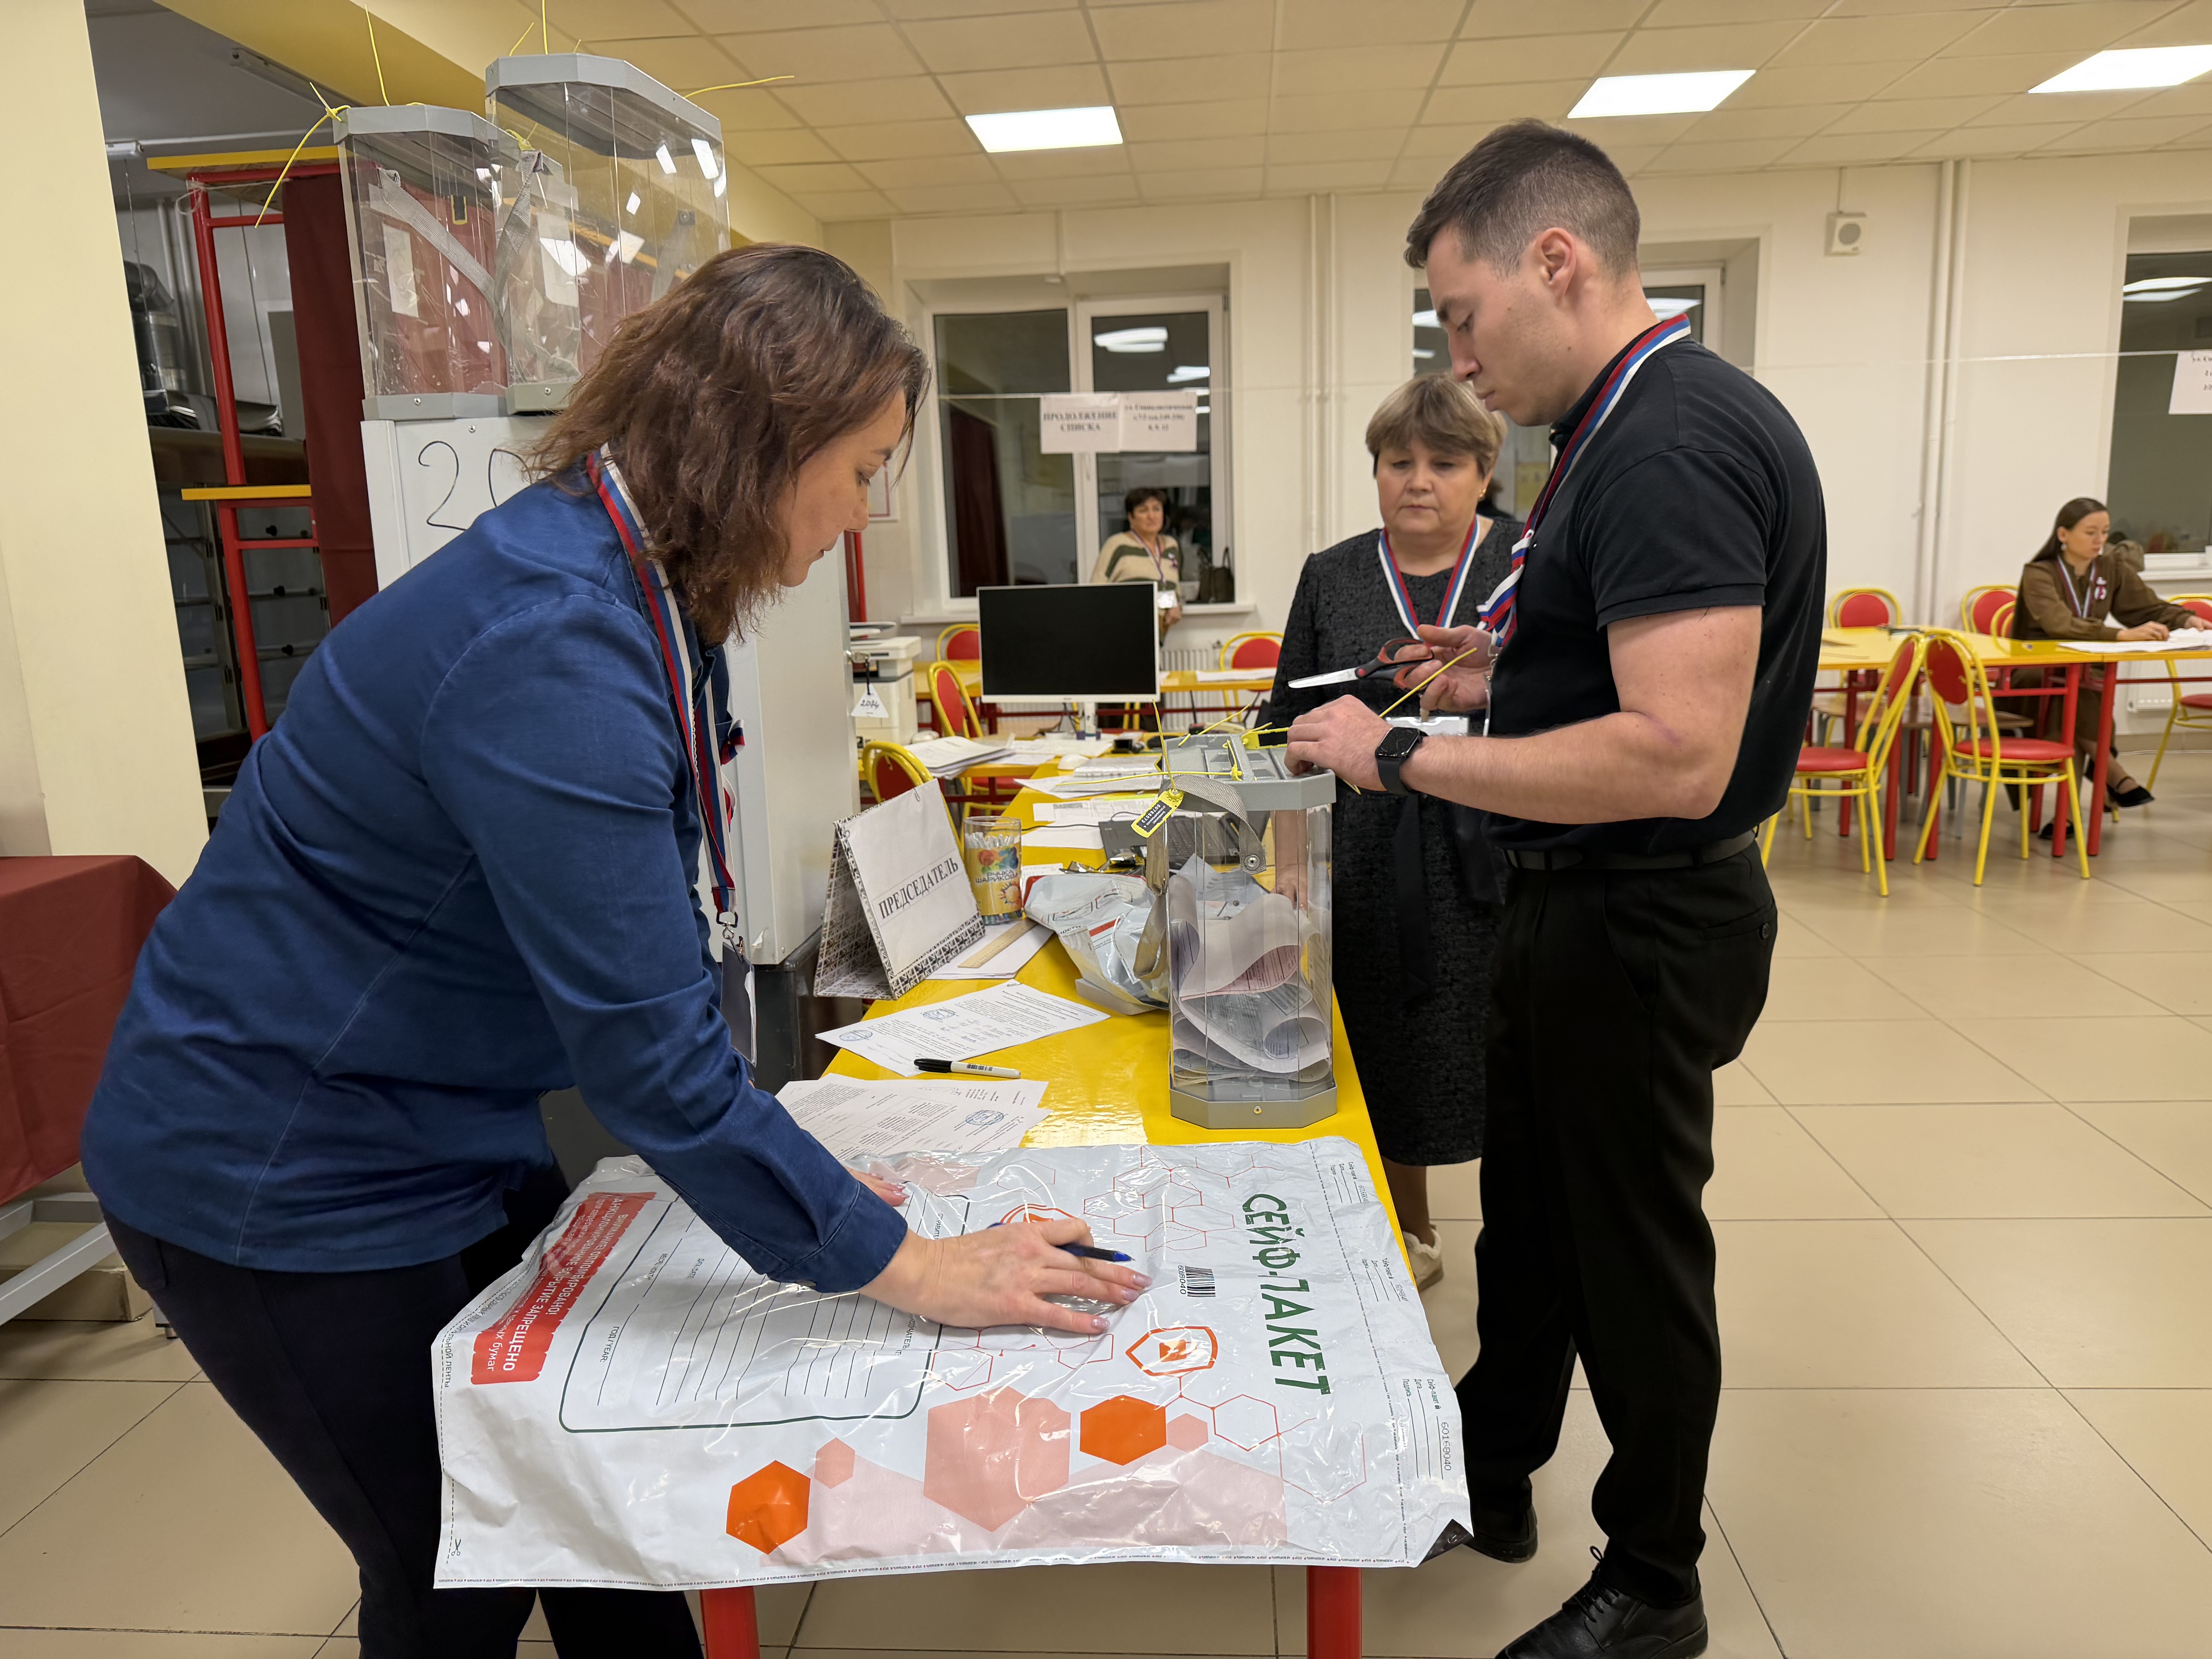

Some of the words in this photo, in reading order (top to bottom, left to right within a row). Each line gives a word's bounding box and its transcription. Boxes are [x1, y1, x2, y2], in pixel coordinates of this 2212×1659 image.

[878, 857, 959, 919] ПРЕДСЕДАТЕЛЬ
[1242, 1194, 1331, 1395] СЕЙФ-ПАКЕТ
[487, 1342, 503, 1372] бумаг
[503, 1304, 544, 1371] ЗАПРЕЩЕНО
[1402, 1379, 1412, 1397] Подпись
[1413, 1379, 1422, 1389] Дата
[1427, 1379, 1439, 1404] Сейф-пакет
[1441, 1422, 1452, 1471] 60168040
